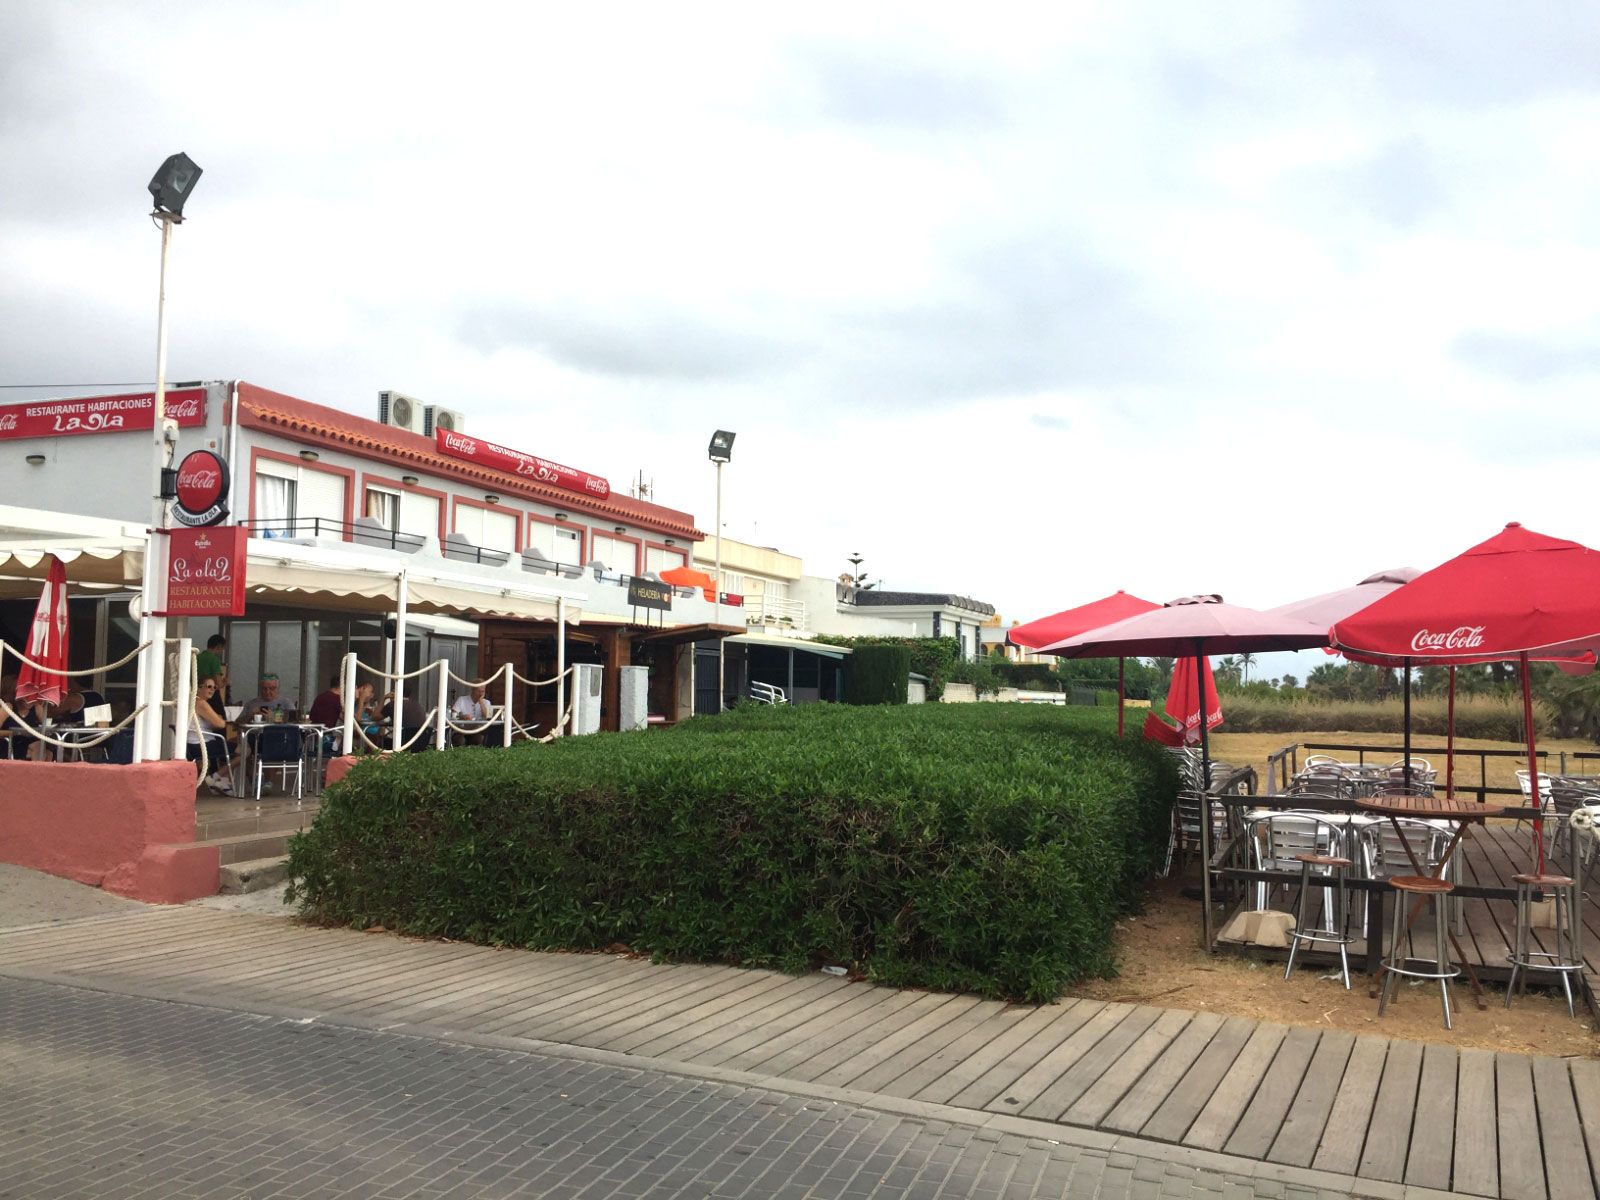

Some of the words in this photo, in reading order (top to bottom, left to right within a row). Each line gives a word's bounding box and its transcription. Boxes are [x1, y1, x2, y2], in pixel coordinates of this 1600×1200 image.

[26, 403, 85, 416] RESTAURANTE
[88, 398, 152, 411] HABITACIONES
[53, 415, 80, 431] La
[81, 413, 124, 431] Ola
[446, 433, 476, 455] Coca-Cola
[487, 443, 534, 463] RESTAURANTE
[536, 459, 578, 476] HABITACIONES
[516, 460, 535, 475] La
[177, 470, 220, 489] Coca-Cola
[173, 505, 201, 525] RESTAURANTE
[201, 514, 209, 522] LA
[208, 507, 218, 518] OLA
[170, 557, 190, 582] La
[169, 585, 232, 596] RESTAURANTE
[169, 599, 231, 609] HABITACIONES
[1411, 626, 1486, 651] Coca-Cola
